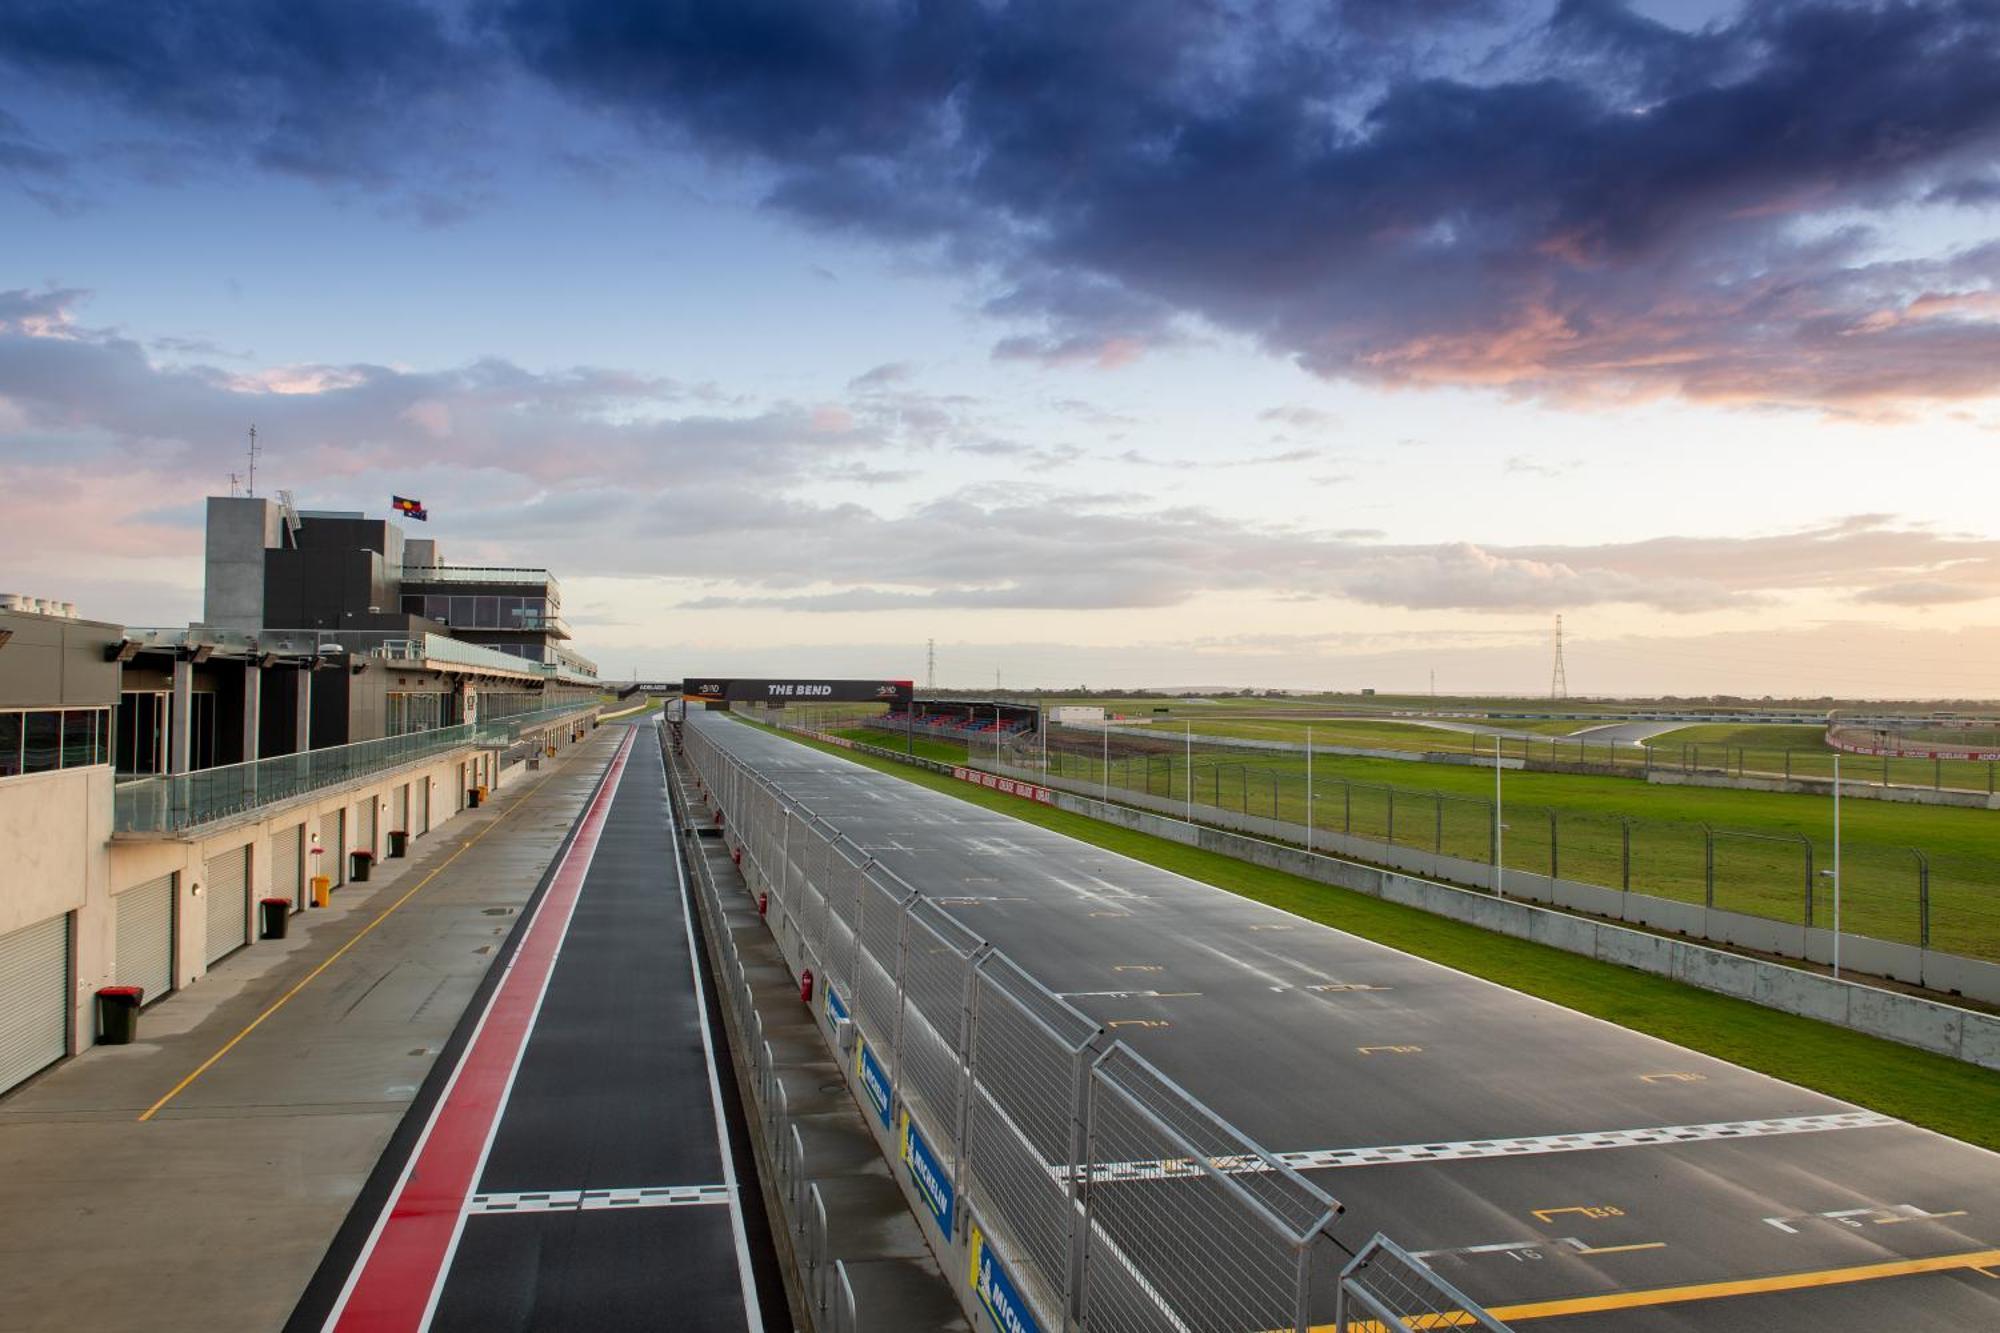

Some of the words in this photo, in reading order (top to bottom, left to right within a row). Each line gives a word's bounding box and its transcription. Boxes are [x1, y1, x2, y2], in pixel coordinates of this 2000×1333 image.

[767, 684, 790, 696] THE
[795, 685, 832, 696] BEND
[914, 1150, 948, 1215] MICHELIN
[1506, 1249, 1543, 1262] 16
